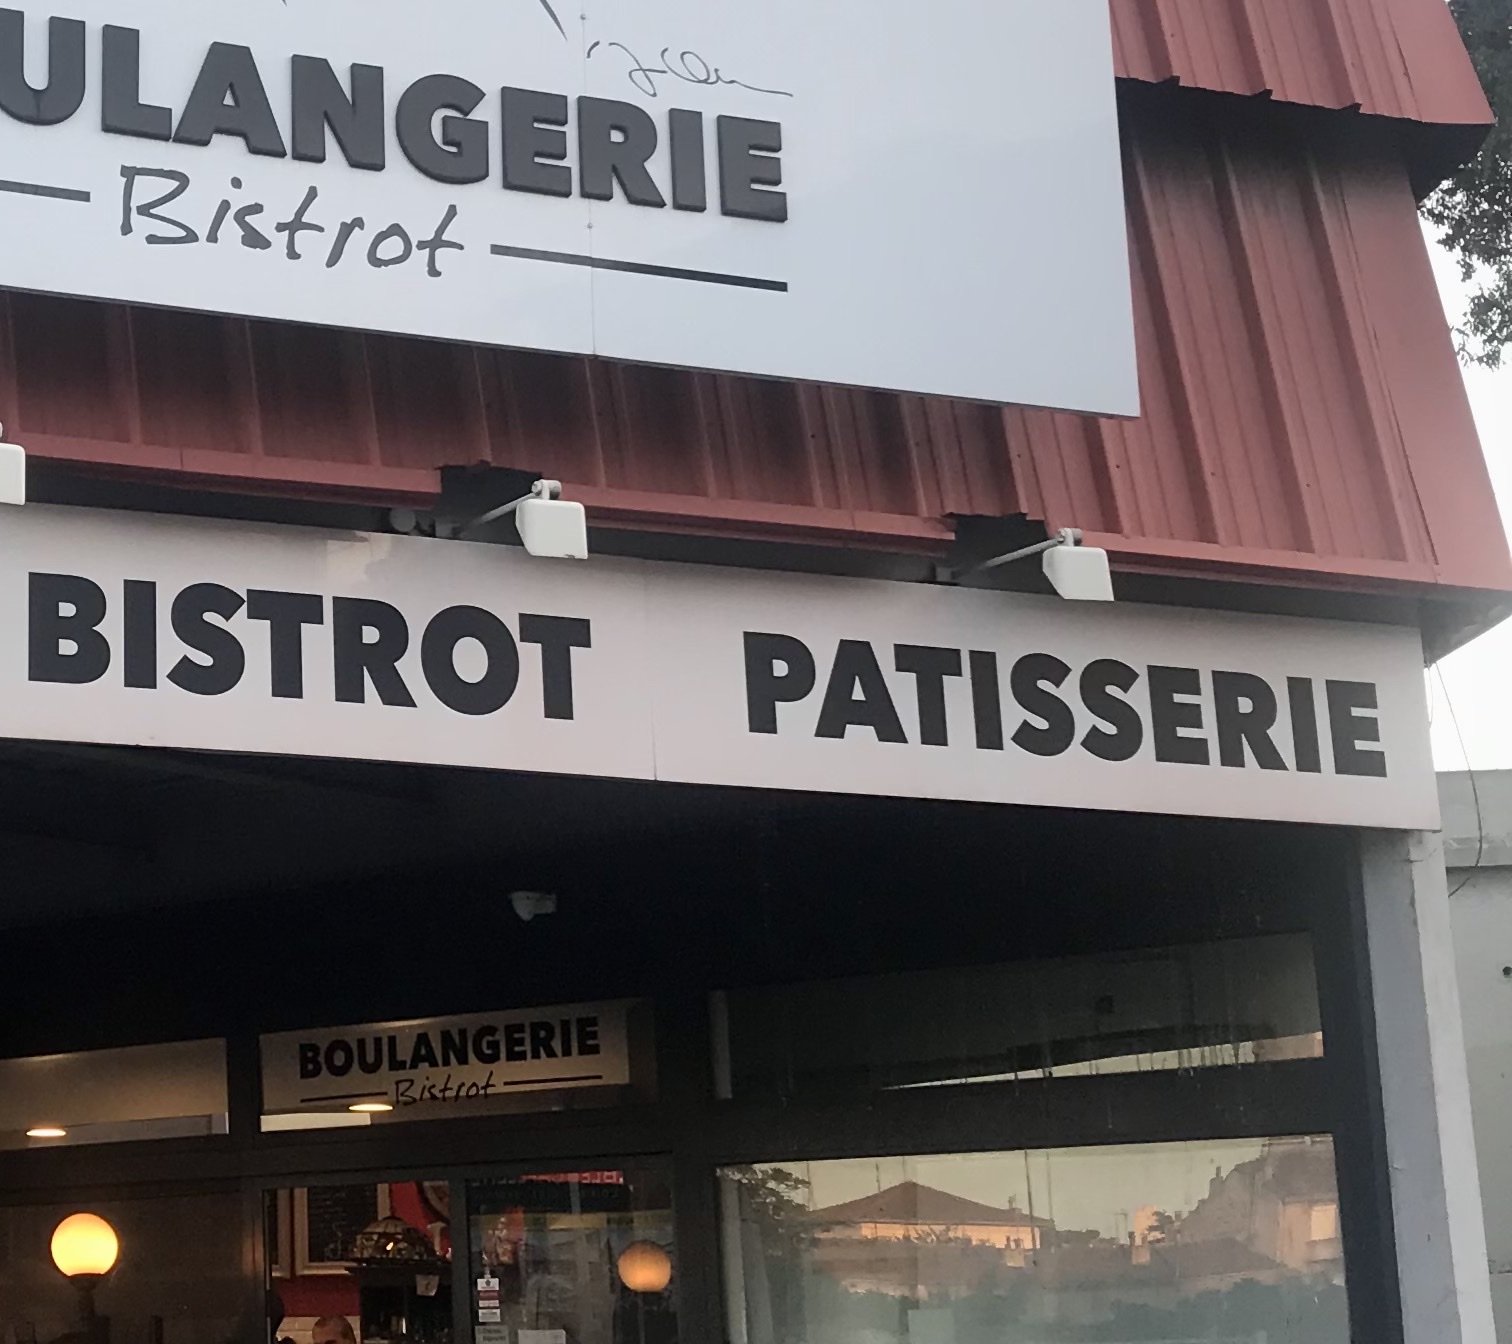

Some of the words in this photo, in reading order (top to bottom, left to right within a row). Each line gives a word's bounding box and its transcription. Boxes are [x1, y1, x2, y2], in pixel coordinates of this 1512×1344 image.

[120, 164, 465, 278] Bistrot
[28, 571, 592, 721] BISTROT
[743, 630, 1388, 778] PATISSERIE
[298, 1016, 601, 1080] BOULANGERIE
[394, 1070, 497, 1106] Bistrot
